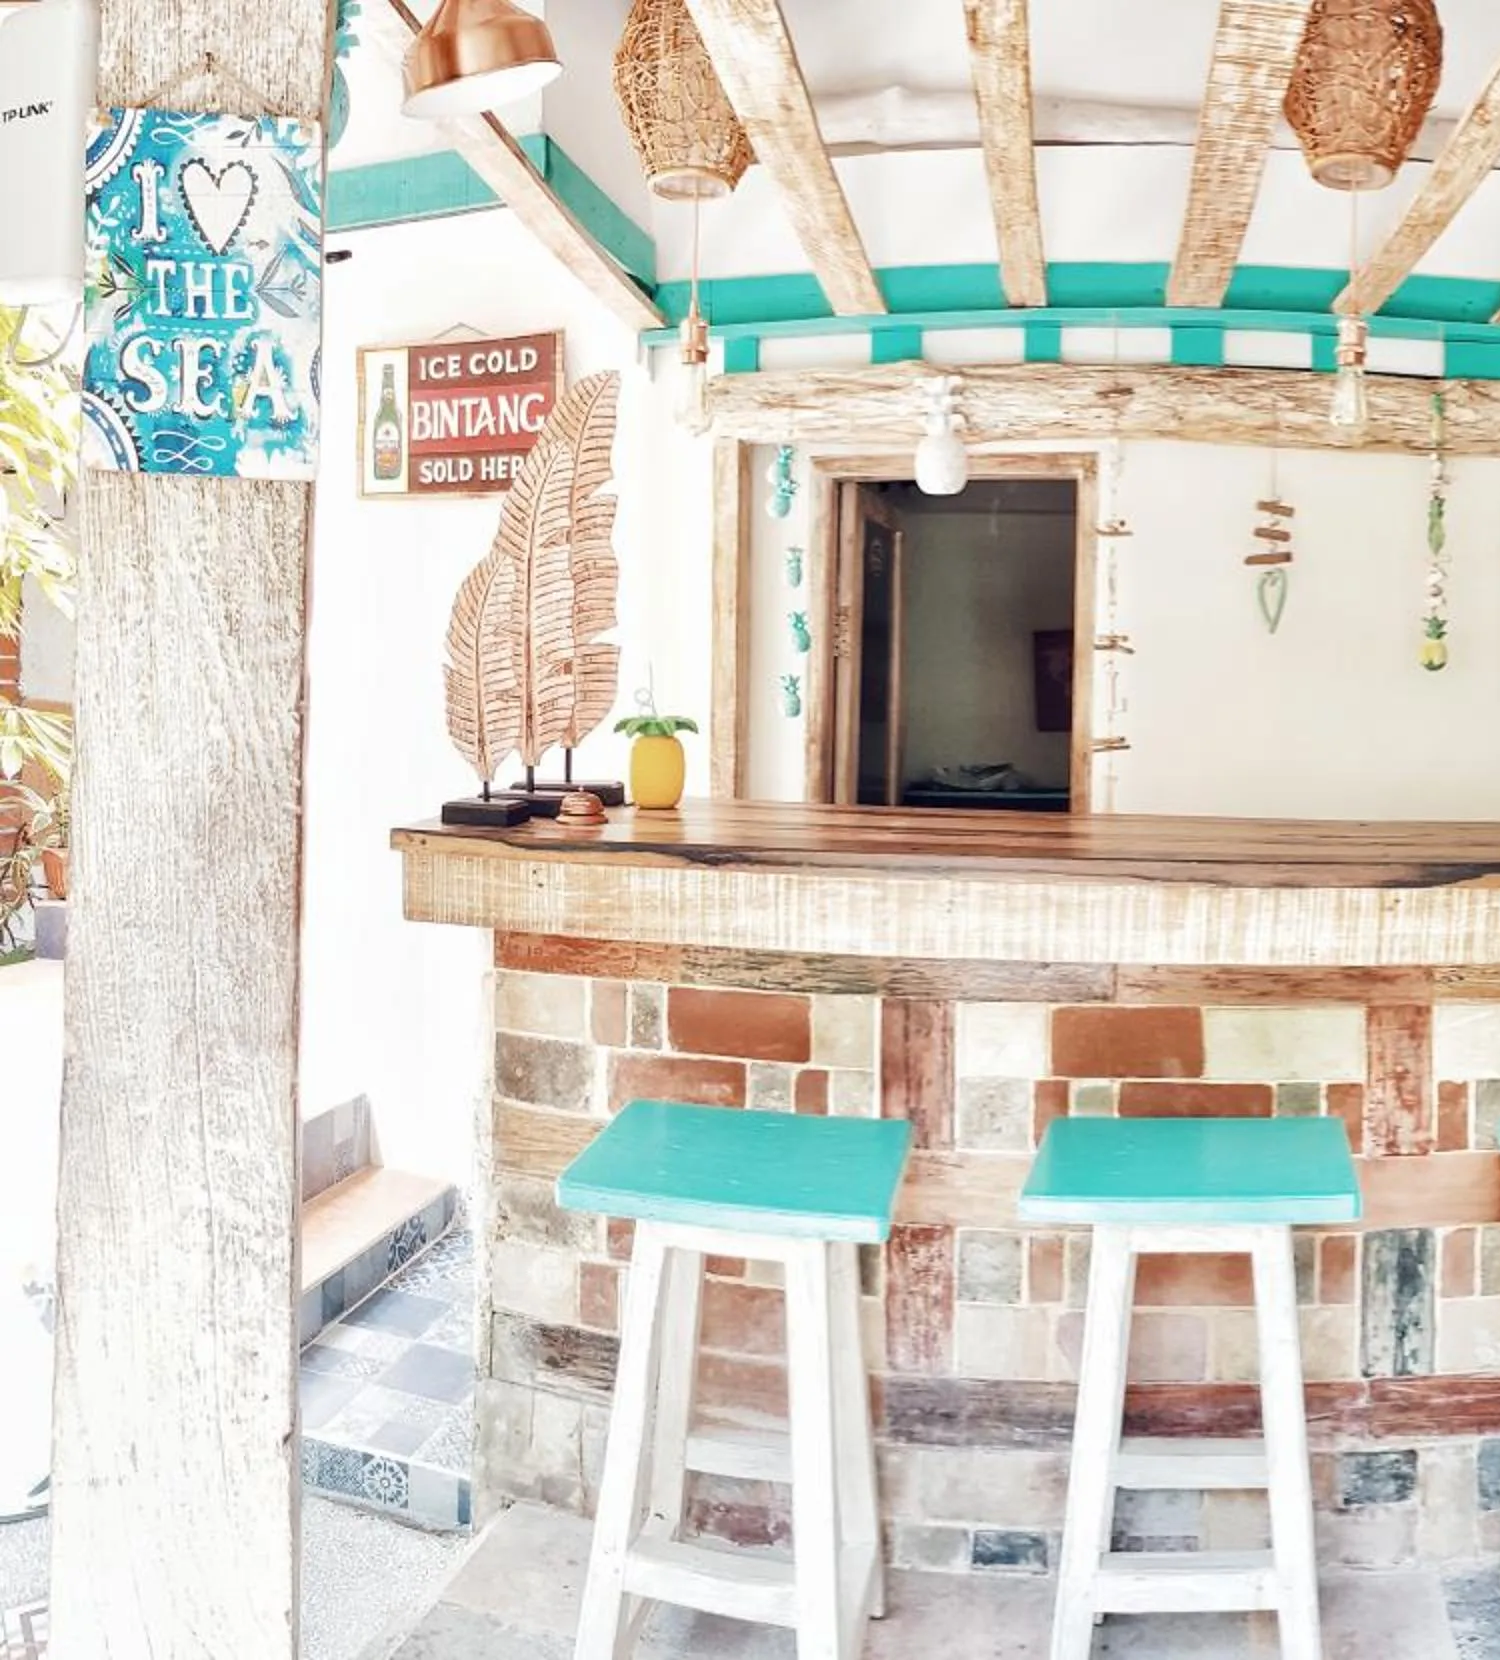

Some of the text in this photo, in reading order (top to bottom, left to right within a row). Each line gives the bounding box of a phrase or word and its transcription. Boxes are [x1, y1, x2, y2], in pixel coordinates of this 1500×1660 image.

[130, 158, 168, 244] I
[147, 261, 254, 321] THE
[119, 334, 299, 429] SEA
[419, 348, 538, 381] ICE COLD
[411, 393, 546, 441] BINTANG
[419, 455, 527, 484] SOLD HER
